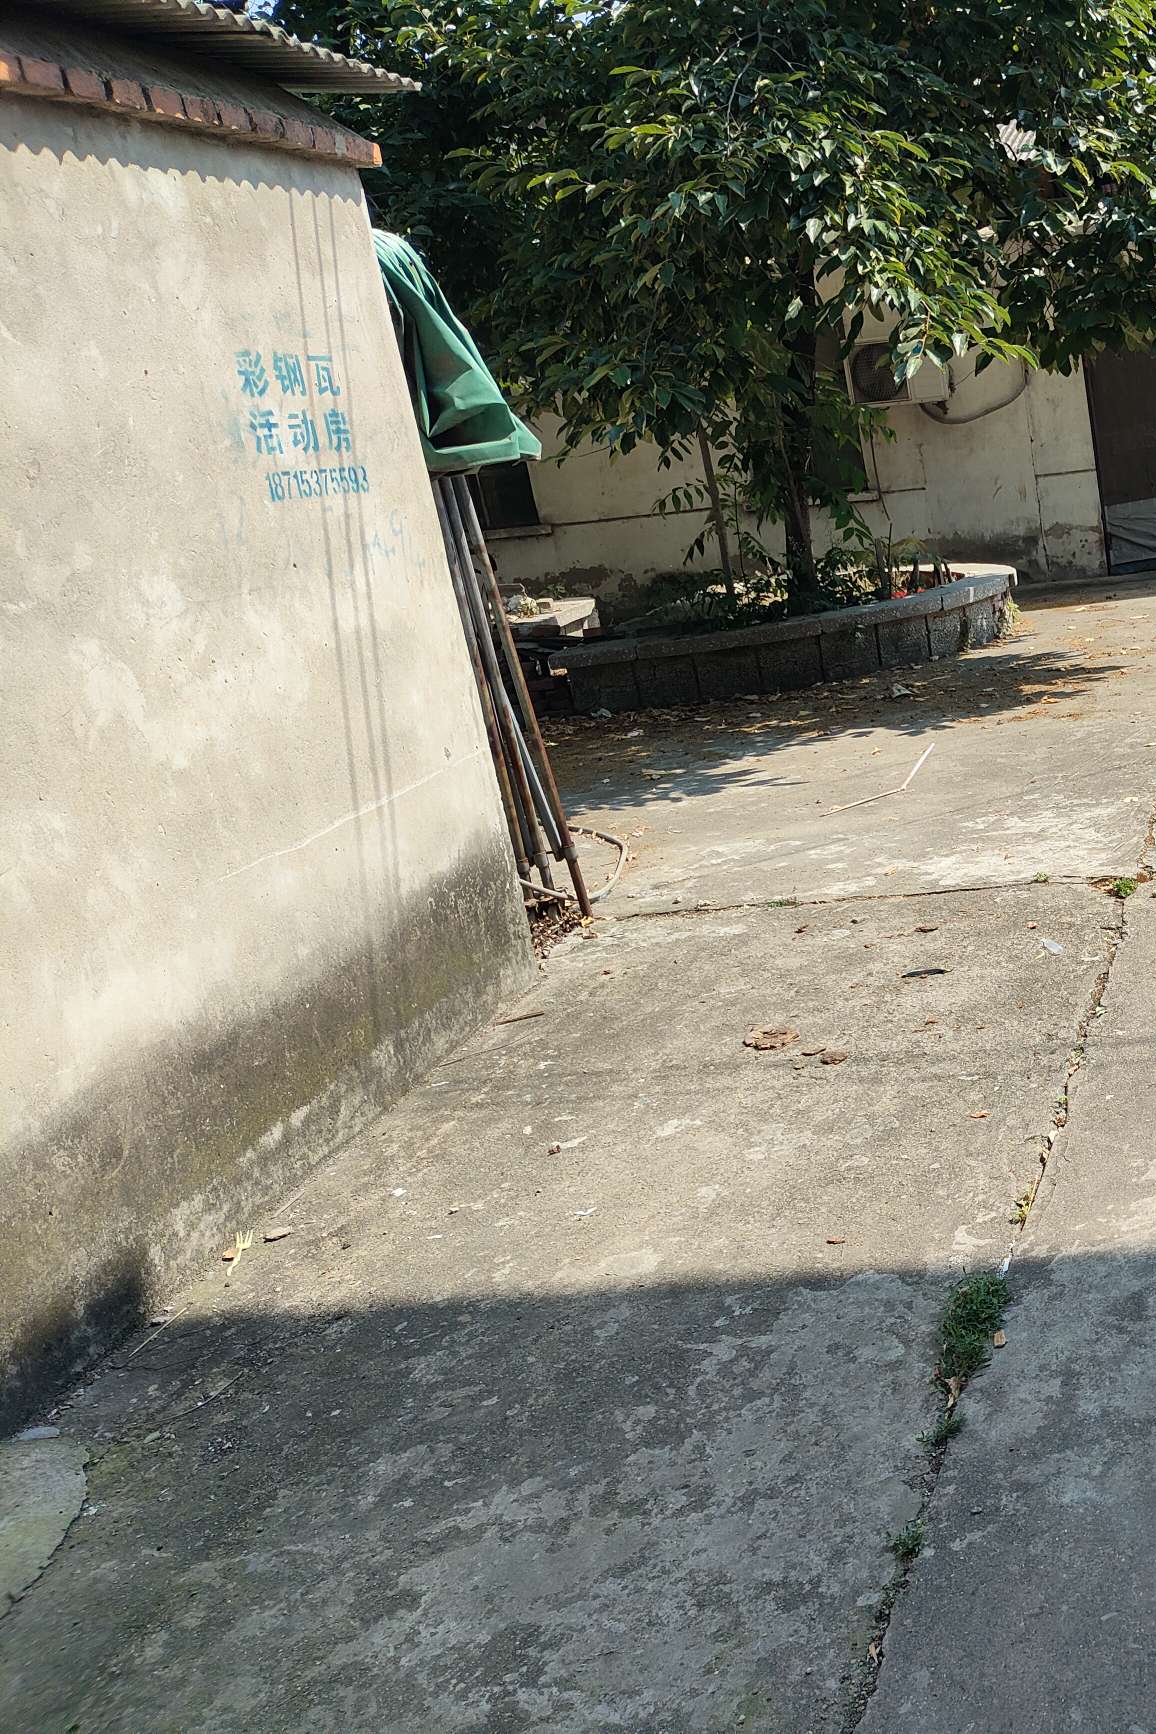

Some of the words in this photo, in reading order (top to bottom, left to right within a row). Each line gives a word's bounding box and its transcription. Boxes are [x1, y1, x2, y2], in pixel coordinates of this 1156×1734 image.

[234, 350, 340, 398] 彩钢瓦
[249, 408, 352, 455] 活动房
